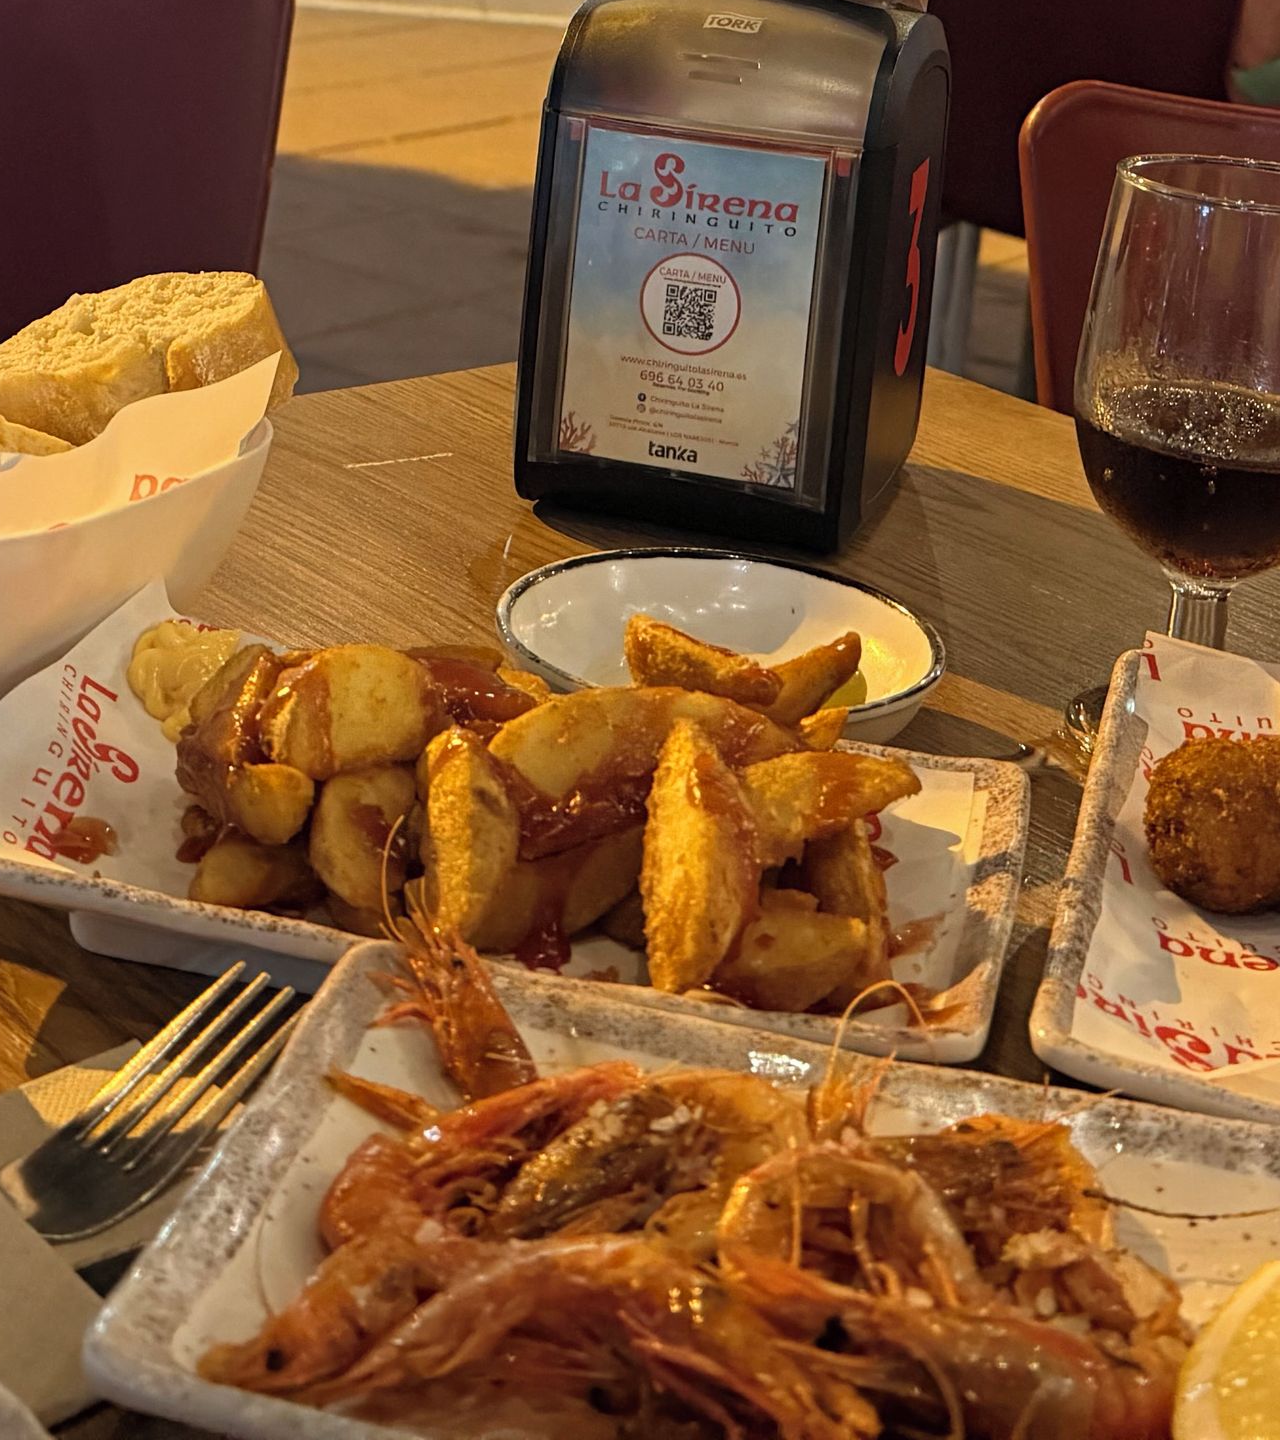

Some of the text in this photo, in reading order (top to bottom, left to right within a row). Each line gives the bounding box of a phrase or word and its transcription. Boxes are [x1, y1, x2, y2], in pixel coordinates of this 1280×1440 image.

[708, 16, 760, 31] TORK
[599, 170, 642, 202] La
[598, 201, 797, 238] CHIRINGUITO
[634, 226, 755, 255] CARTA / MENU
[659, 266, 690, 279] CARTA
[698, 271, 727, 284] MENU
[620, 355, 747, 381] www.chiringuitolasirena.es
[639, 369, 664, 383] 696
[668, 374, 683, 386] 64
[688, 377, 704, 389] 03
[708, 380, 724, 392] 40
[76, 674, 119, 728] La
[2, 663, 77, 846] CHIRINGUITO
